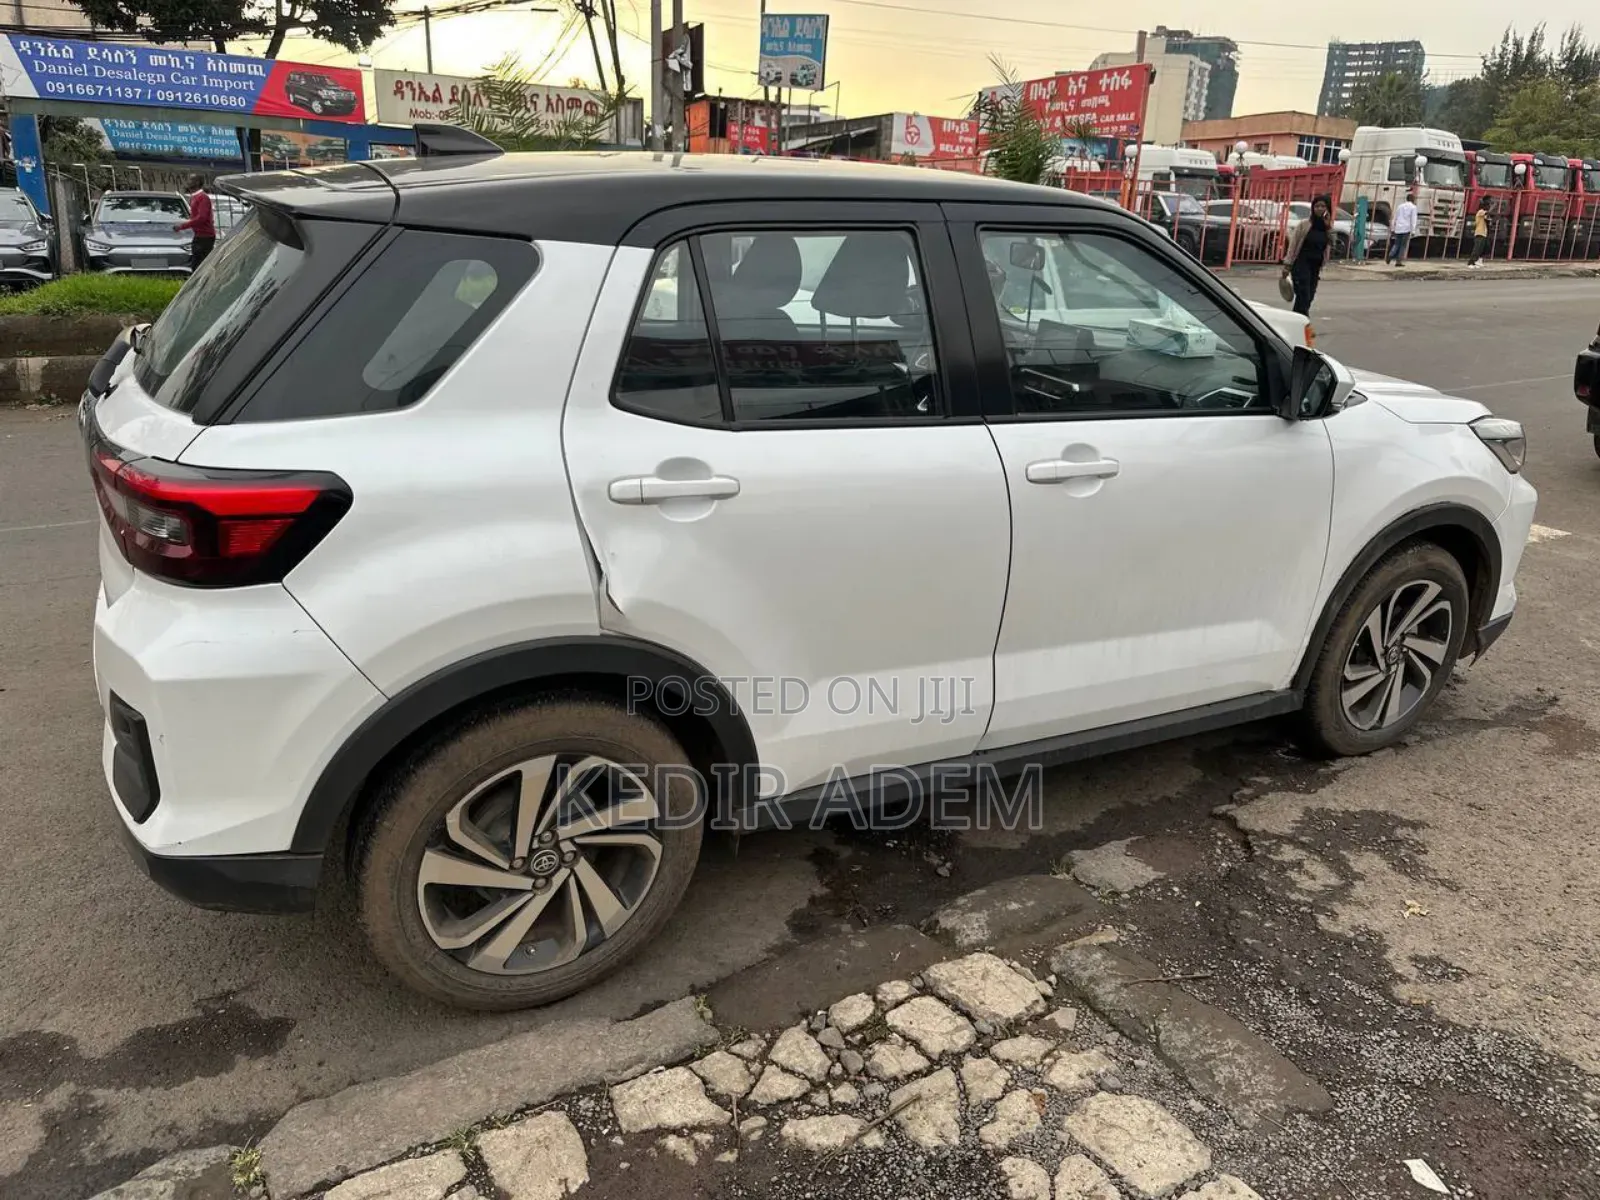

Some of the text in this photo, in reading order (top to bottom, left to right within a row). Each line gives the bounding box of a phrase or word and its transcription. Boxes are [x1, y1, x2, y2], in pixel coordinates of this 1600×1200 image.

[19, 40, 266, 77] ዳንኤል ደሳለኝ መኪና አስመጪ
[33, 60, 255, 91] Daniel Desalegn Car Import
[46, 81, 246, 107] 0916671137 / 0912610680
[393, 79, 443, 104] ዳንኤል
[1100, 114, 1115, 123] CAR
[112, 129, 144, 140] Daniel
